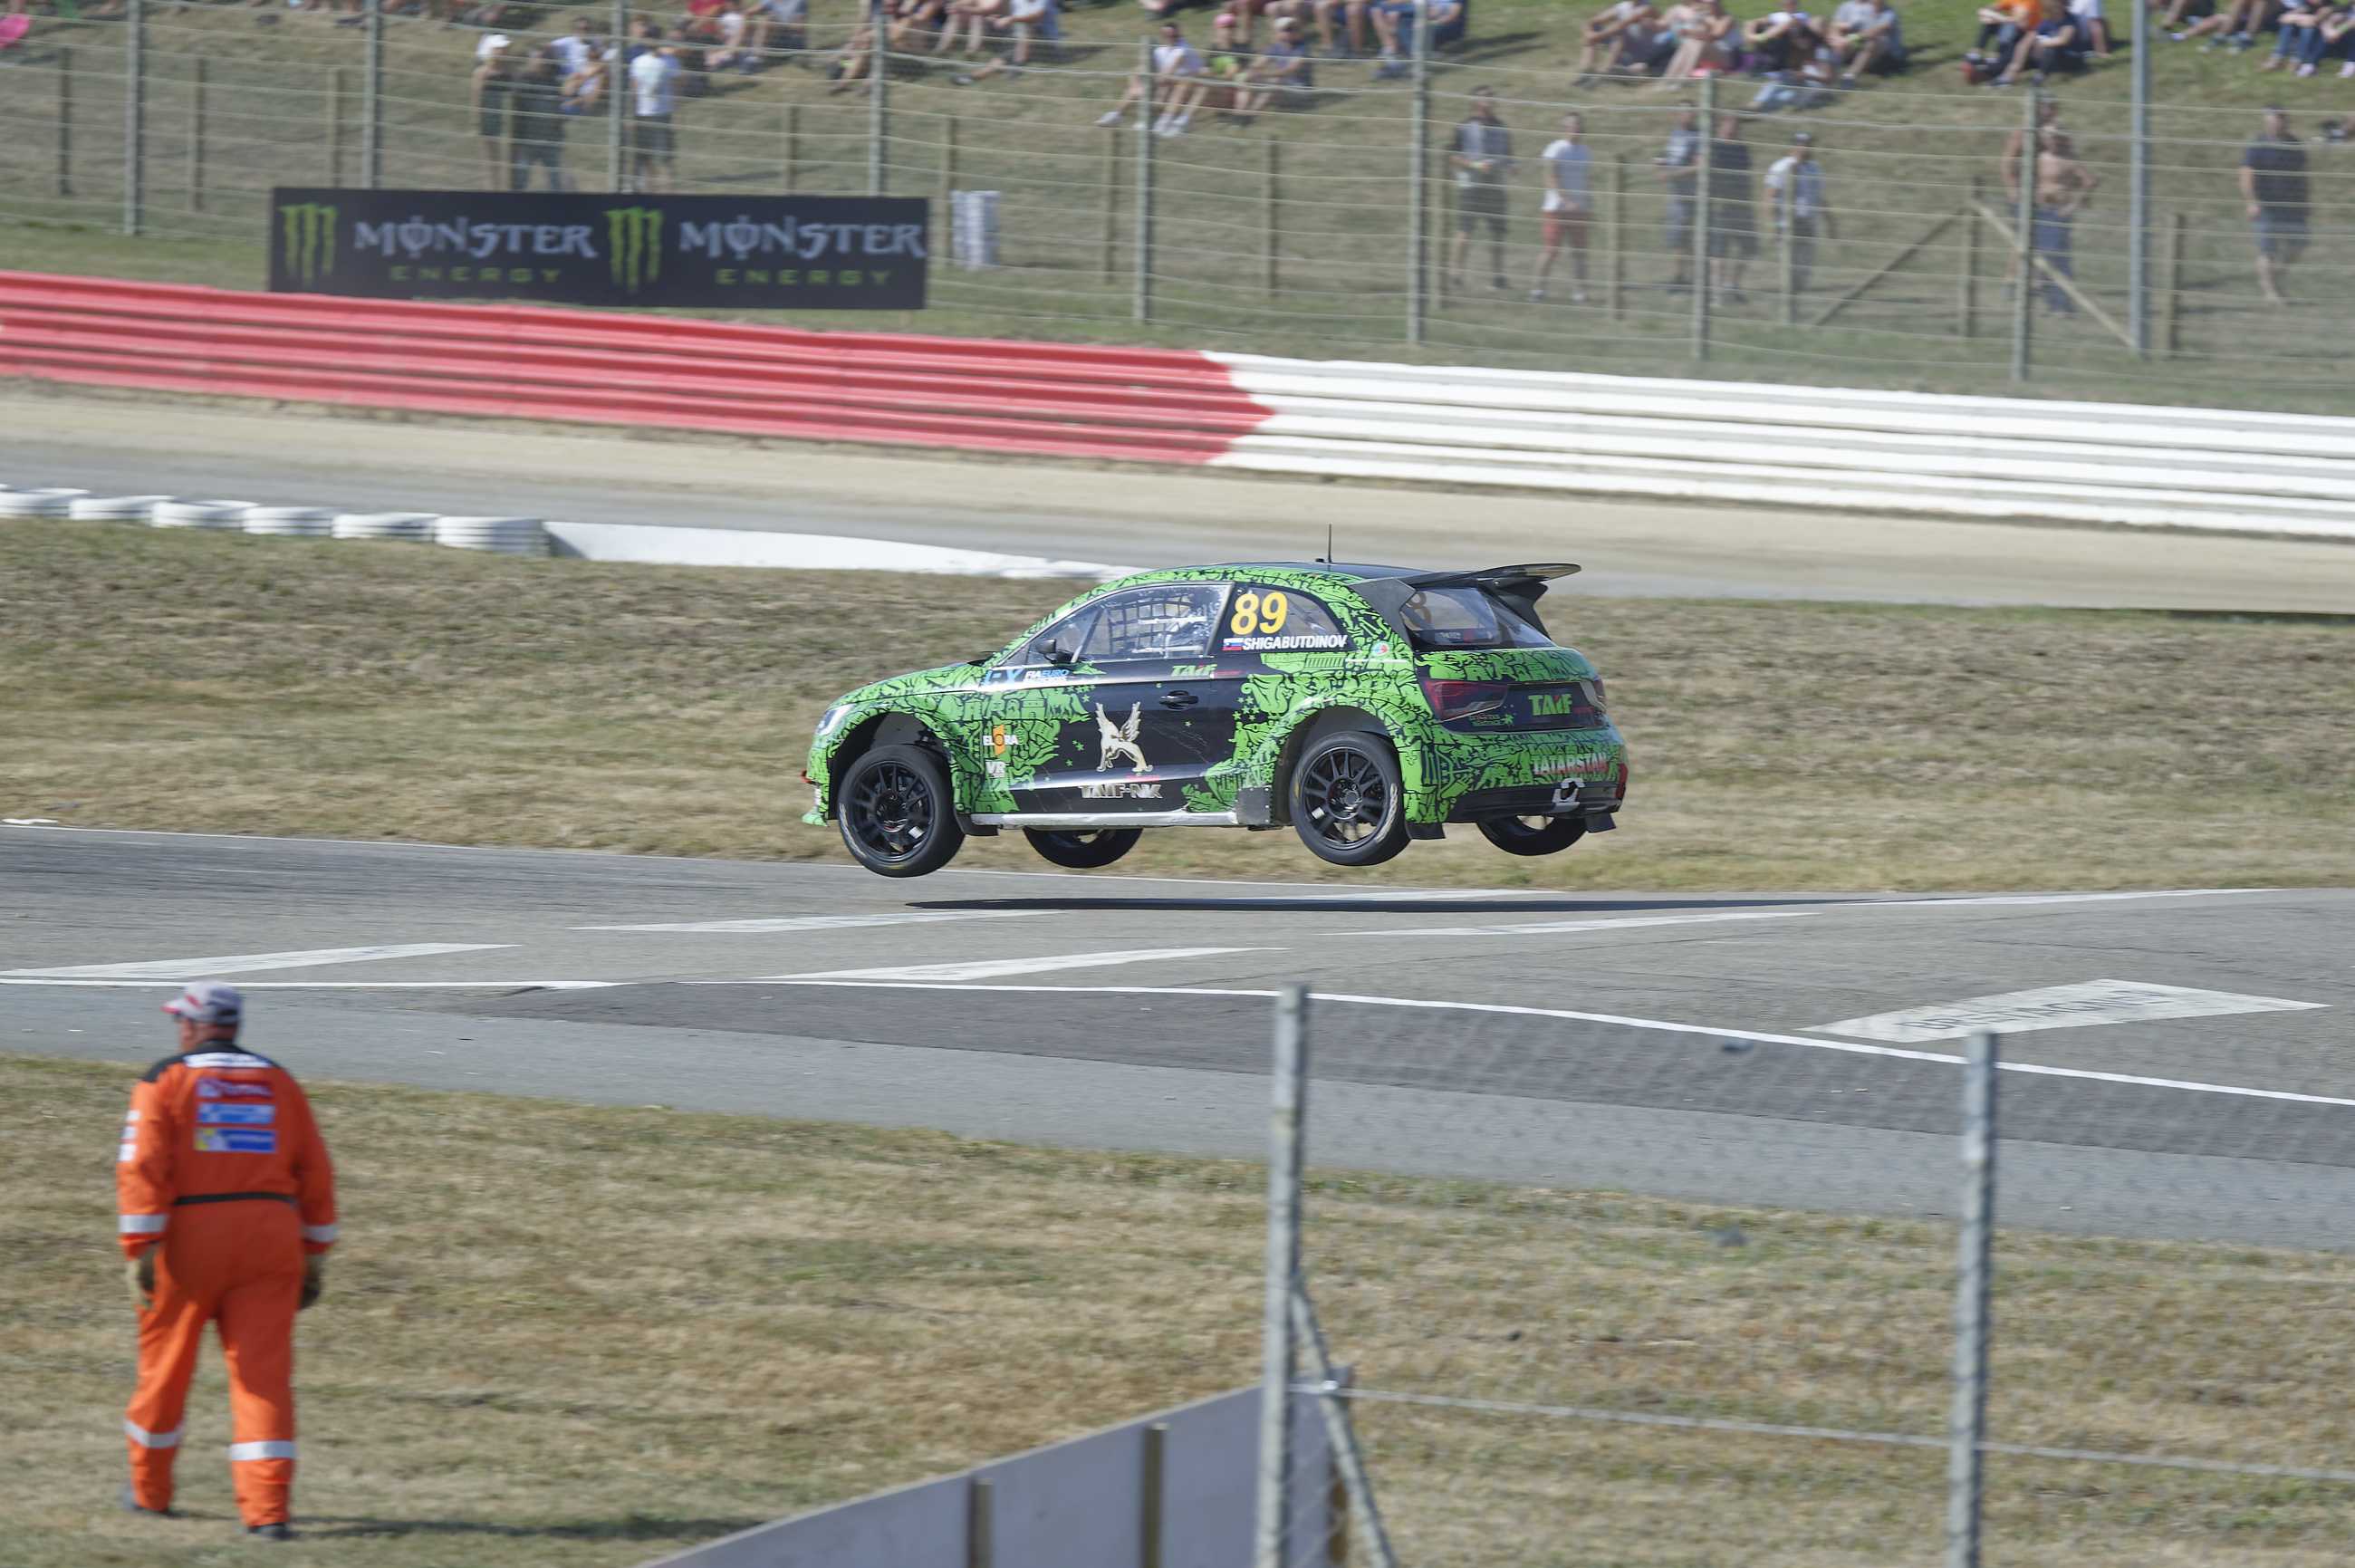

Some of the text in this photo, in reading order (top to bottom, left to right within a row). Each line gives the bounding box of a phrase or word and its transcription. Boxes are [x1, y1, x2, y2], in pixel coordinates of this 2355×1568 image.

[354, 215, 598, 260] MONSTER
[679, 215, 926, 261] MONSTER
[389, 265, 562, 284] ENERGY
[716, 268, 892, 286] ENERGY
[1230, 591, 1288, 635] 89
[1243, 635, 1348, 650] SHIGABUTDINOV
[1528, 694, 1572, 716] TAIF
[1532, 753, 1609, 775] TATARSTAN
